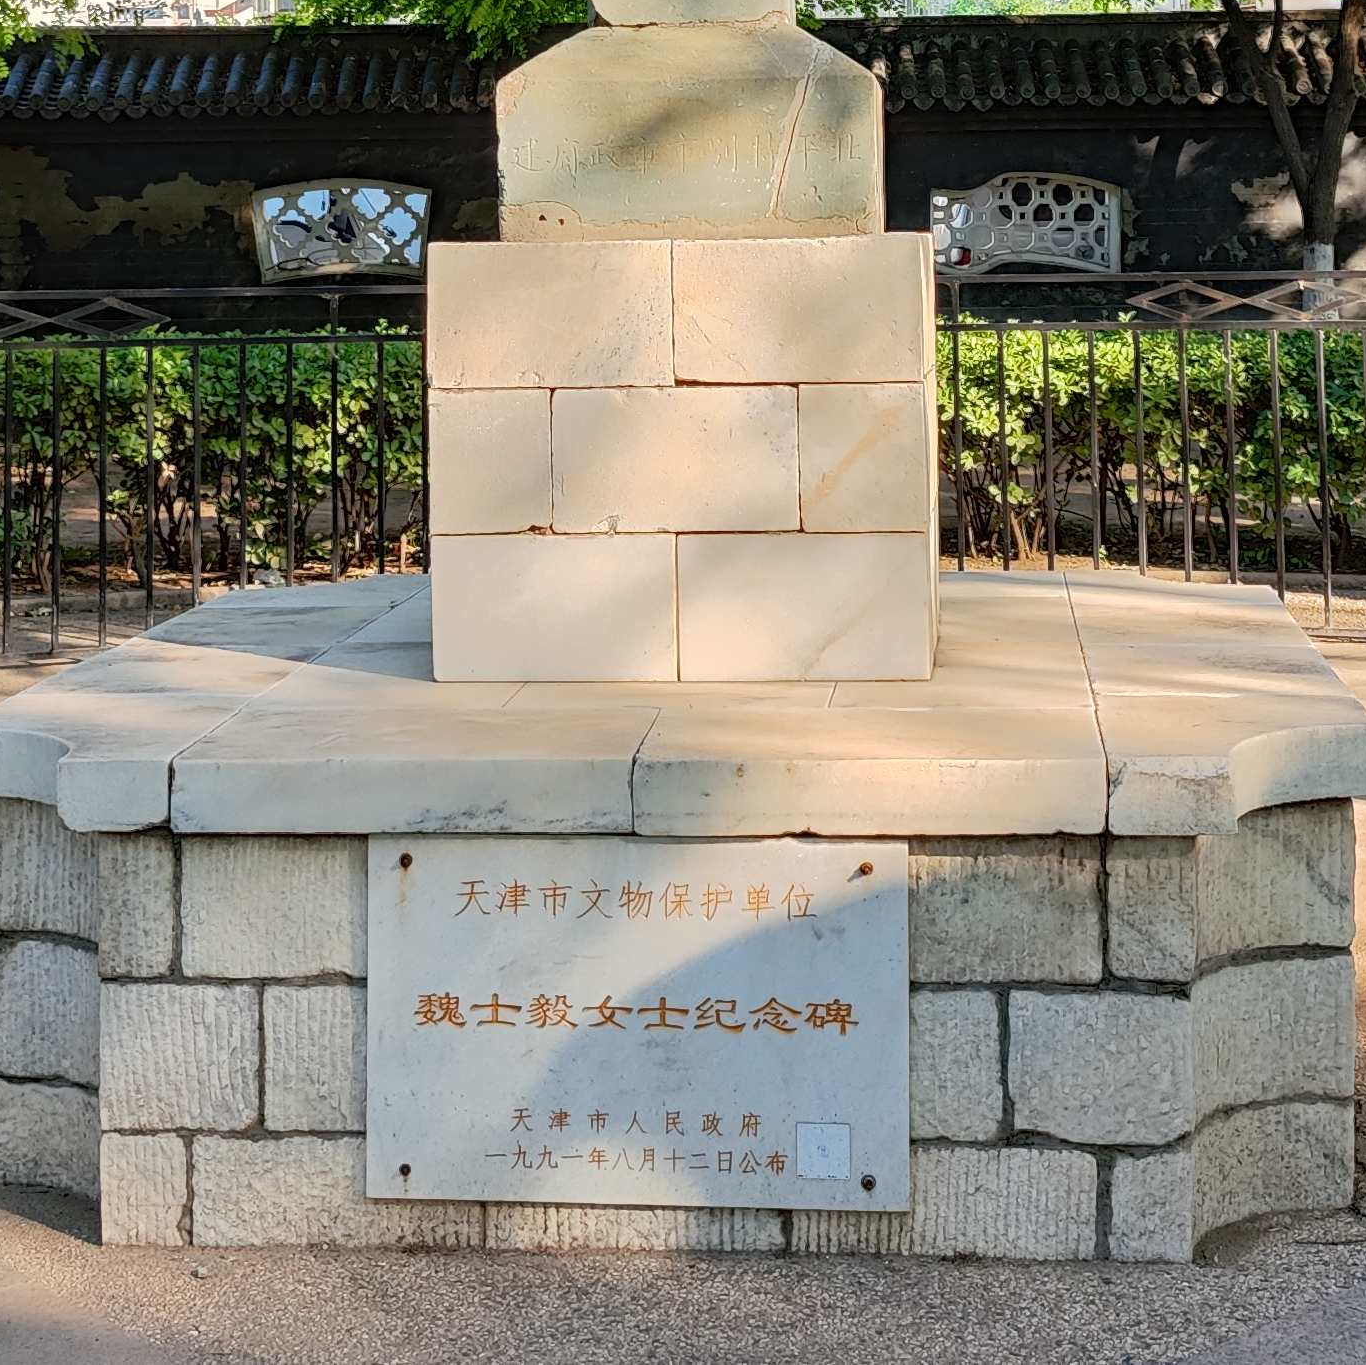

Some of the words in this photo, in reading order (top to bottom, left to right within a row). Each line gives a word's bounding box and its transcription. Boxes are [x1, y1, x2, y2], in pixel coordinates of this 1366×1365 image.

[454, 880, 818, 922] 天津市文物保护单位
[414, 992, 860, 1035] 魏士毅女士纪念碑
[510, 1108, 762, 1138] 天津市人民政府
[485, 1145, 789, 1176] 一九九一年八月十二日公布
